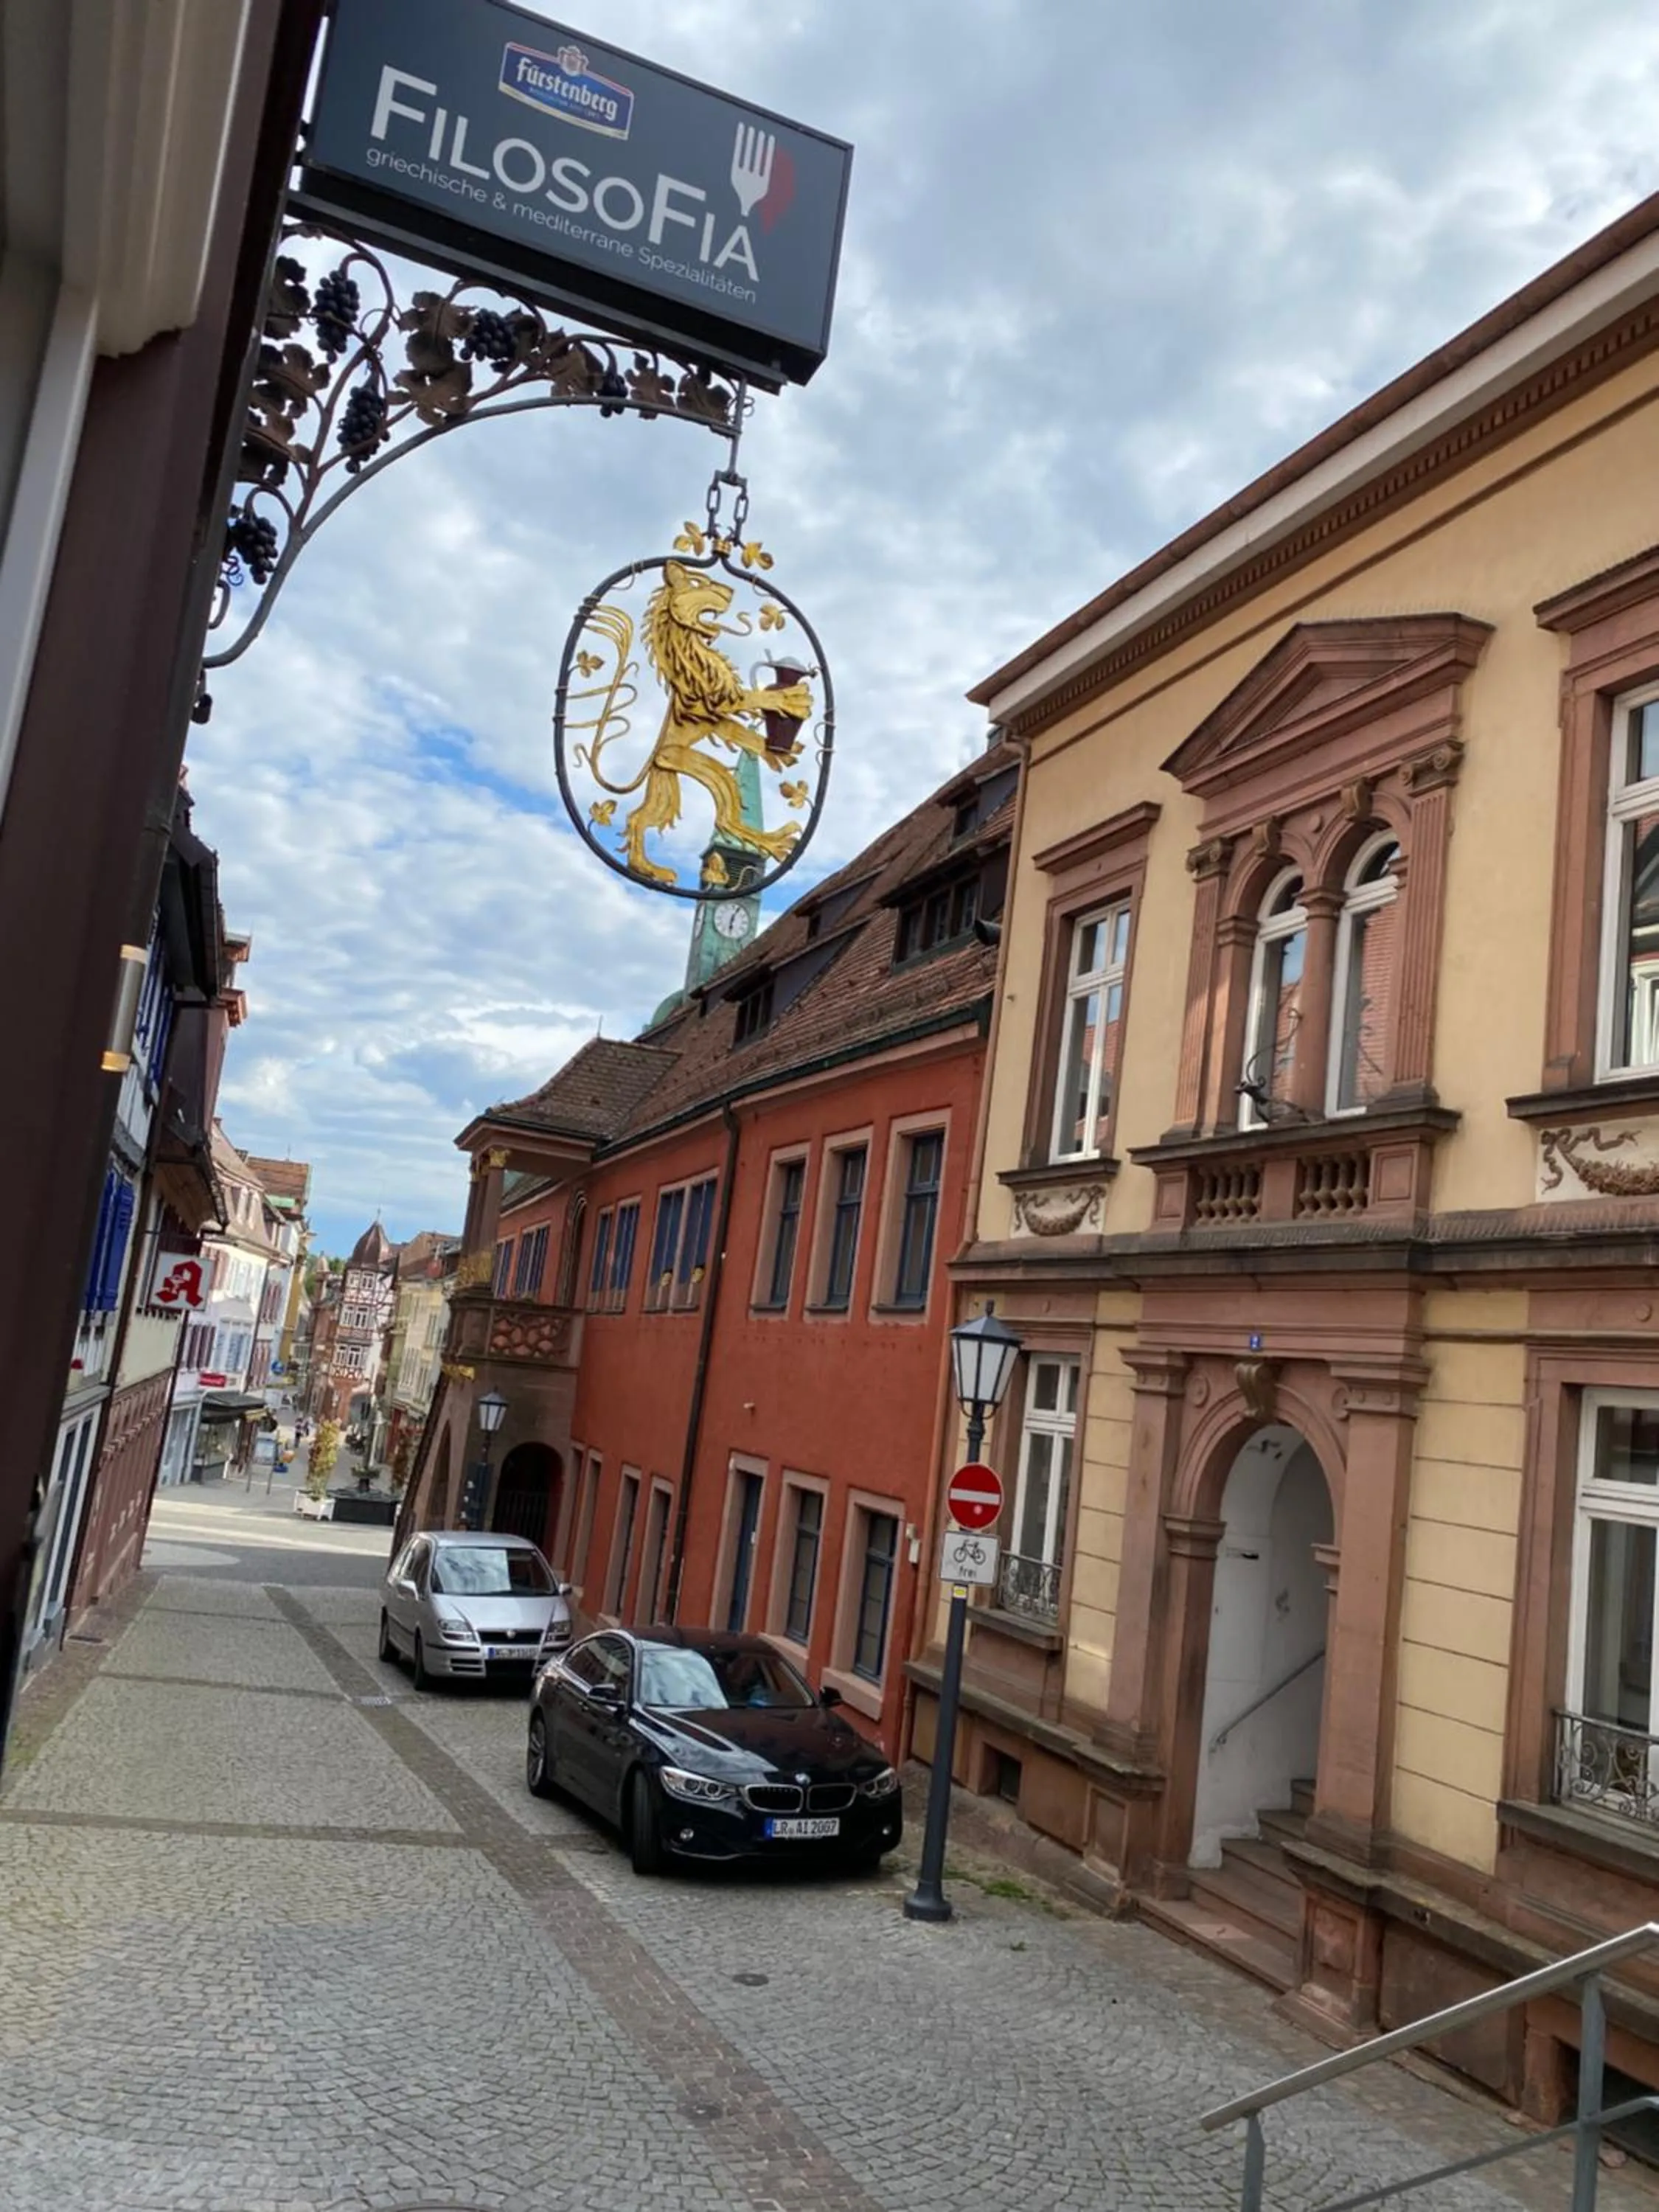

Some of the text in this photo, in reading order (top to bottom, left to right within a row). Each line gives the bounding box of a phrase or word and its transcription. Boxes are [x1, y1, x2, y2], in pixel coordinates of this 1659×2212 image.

[516, 57, 618, 122] Fürstenberg
[366, 147, 757, 304] griechische & mediterrane Spezialitäten
[959, 1565, 976, 1578] frei
